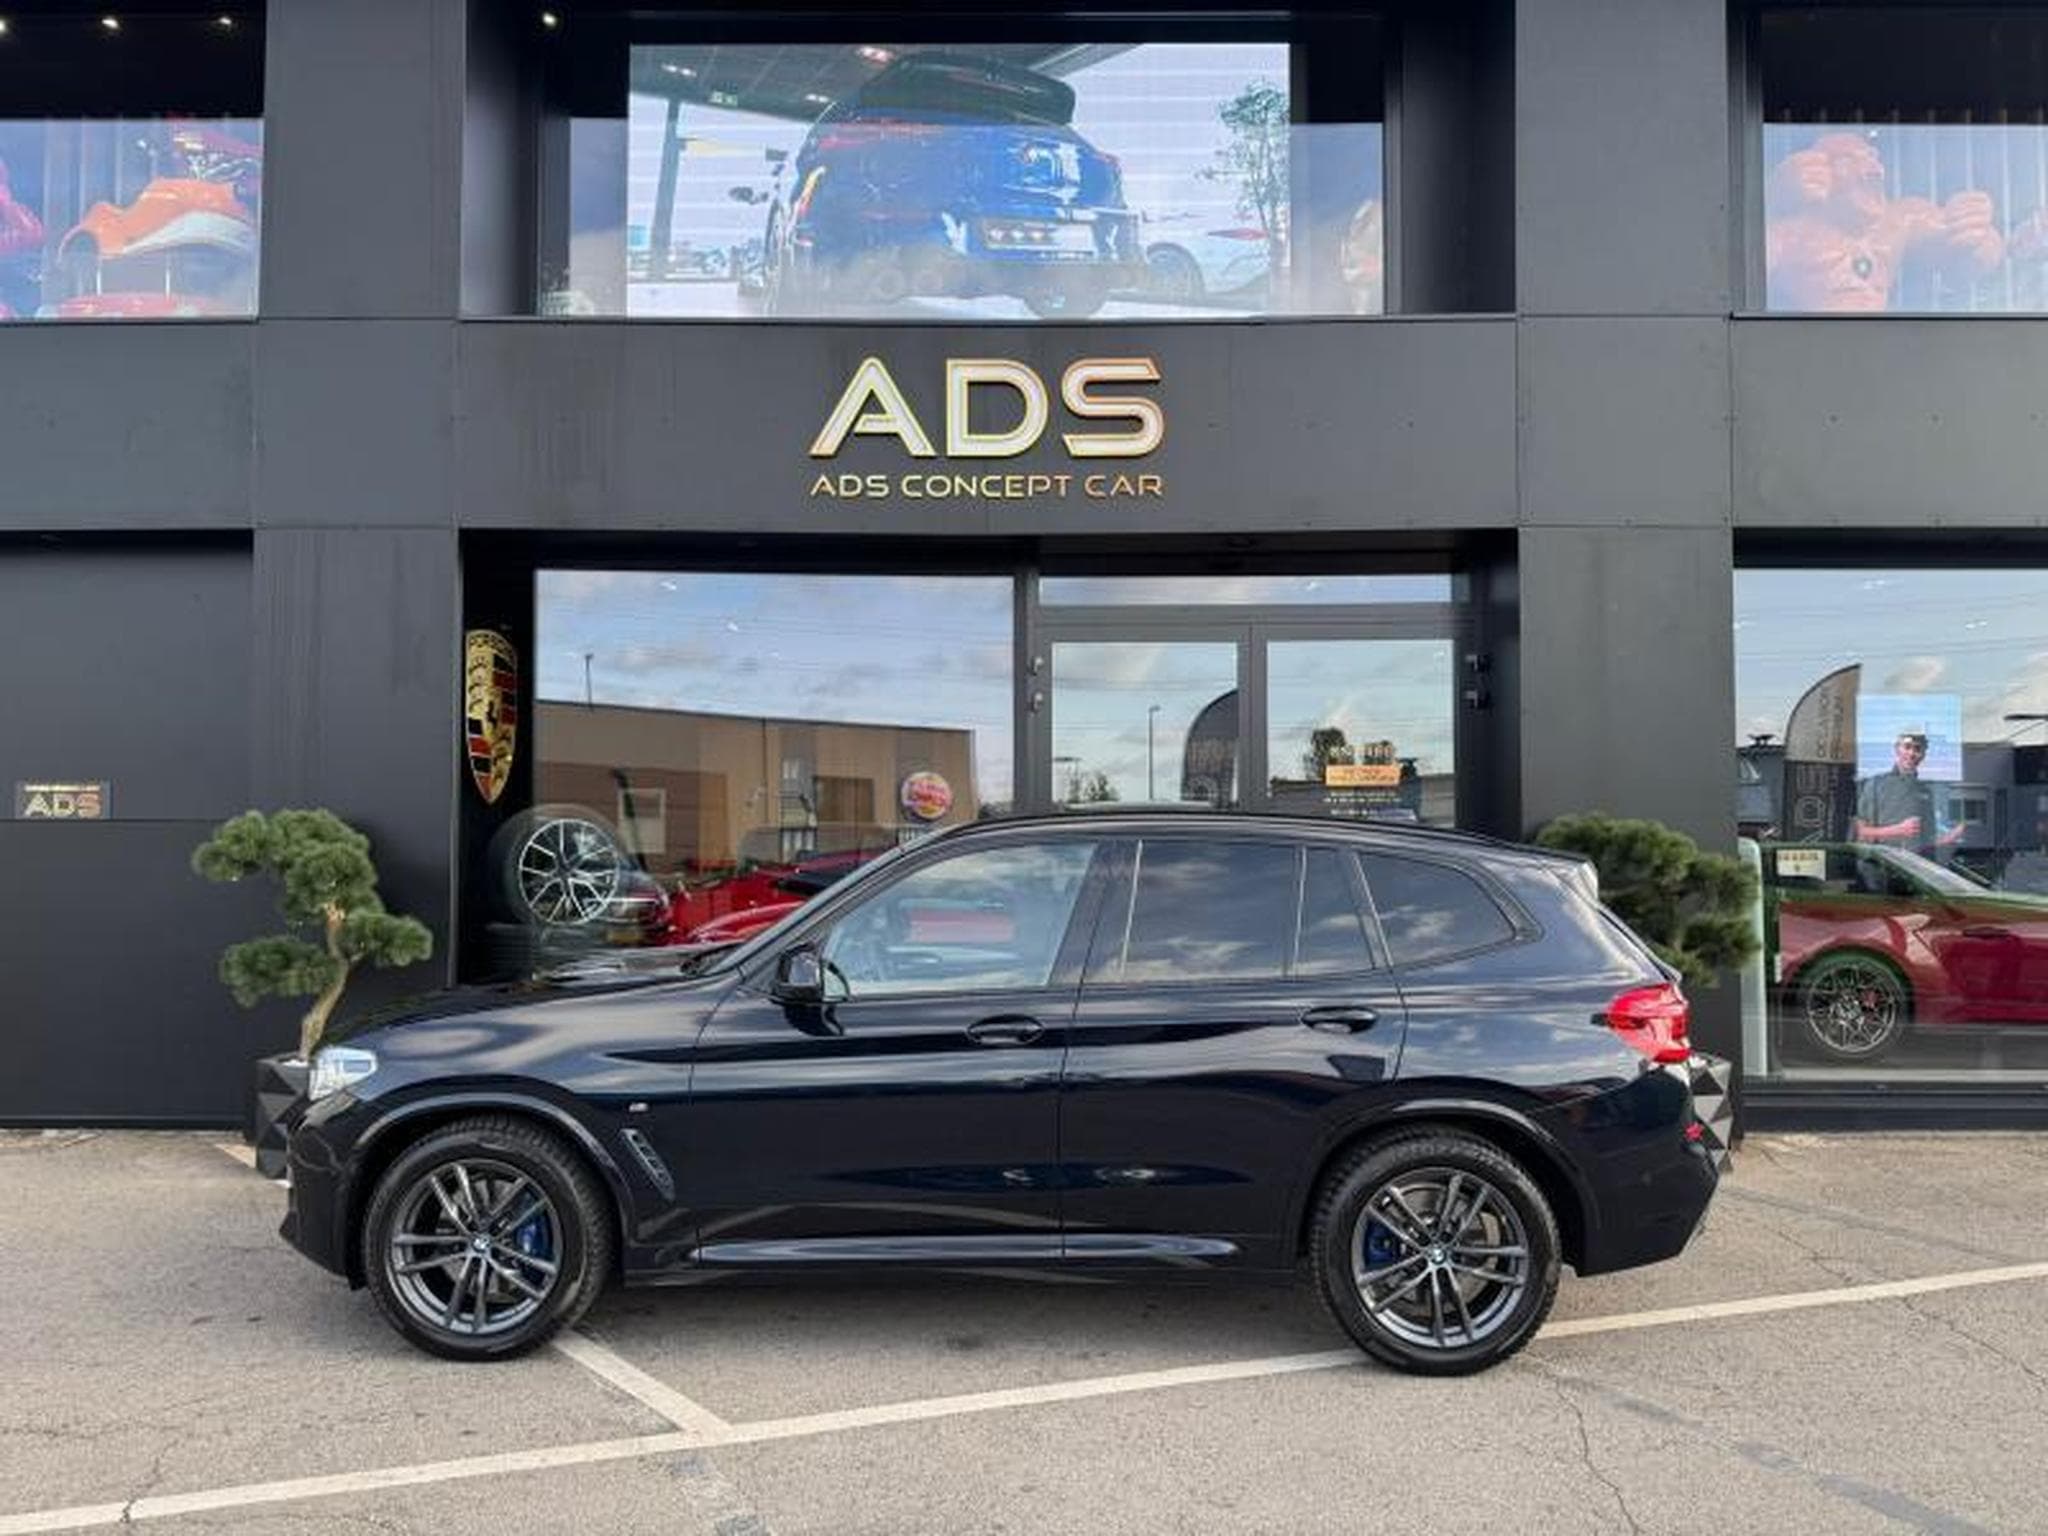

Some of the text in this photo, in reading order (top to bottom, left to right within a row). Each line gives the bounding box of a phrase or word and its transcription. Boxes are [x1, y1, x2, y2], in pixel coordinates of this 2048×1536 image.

[809, 356, 1165, 457] ADS
[810, 474, 1163, 498] ADS CONCEPT CAR
[24, 793, 100, 818] ADS
